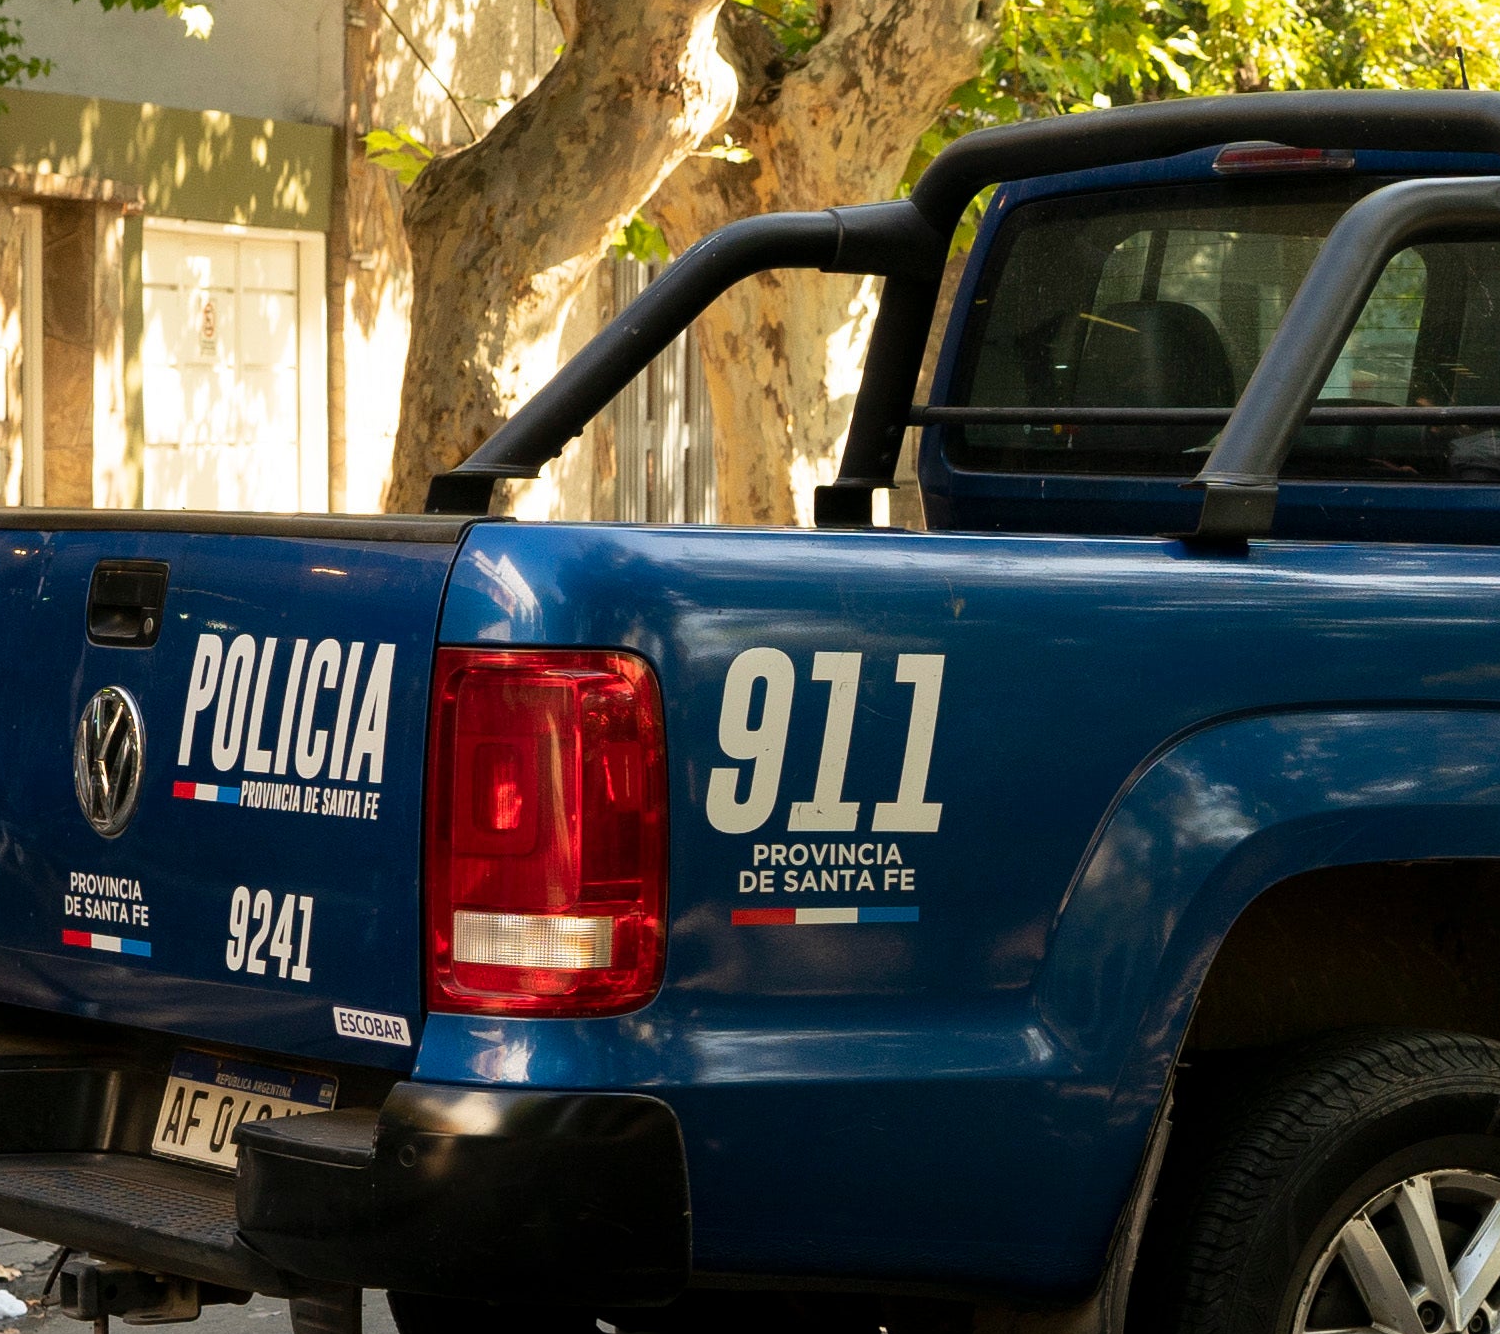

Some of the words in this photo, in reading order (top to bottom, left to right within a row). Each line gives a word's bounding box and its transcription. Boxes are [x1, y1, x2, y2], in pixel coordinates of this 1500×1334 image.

[178, 634, 396, 784] POLICIA
[706, 647, 945, 834] 911
[240, 780, 301, 812] PROVINCIA
[303, 787, 320, 815] DE
[321, 788, 360, 818] SANTA
[363, 792, 380, 820] FE
[753, 843, 903, 866] PROVINCIA
[70, 872, 142, 901] PROVINCIA
[738, 869, 775, 893] DE
[783, 869, 875, 893] SANTA
[884, 869, 916, 891] FE
[65, 894, 81, 917] DE
[85, 897, 129, 924] SANTA
[132, 904, 149, 927] FE
[226, 886, 314, 982] 9241
[340, 1012, 405, 1041] ESCOBAR
[252, 1079, 292, 1099] ARGENTINA
[162, 1086, 210, 1146] AF
